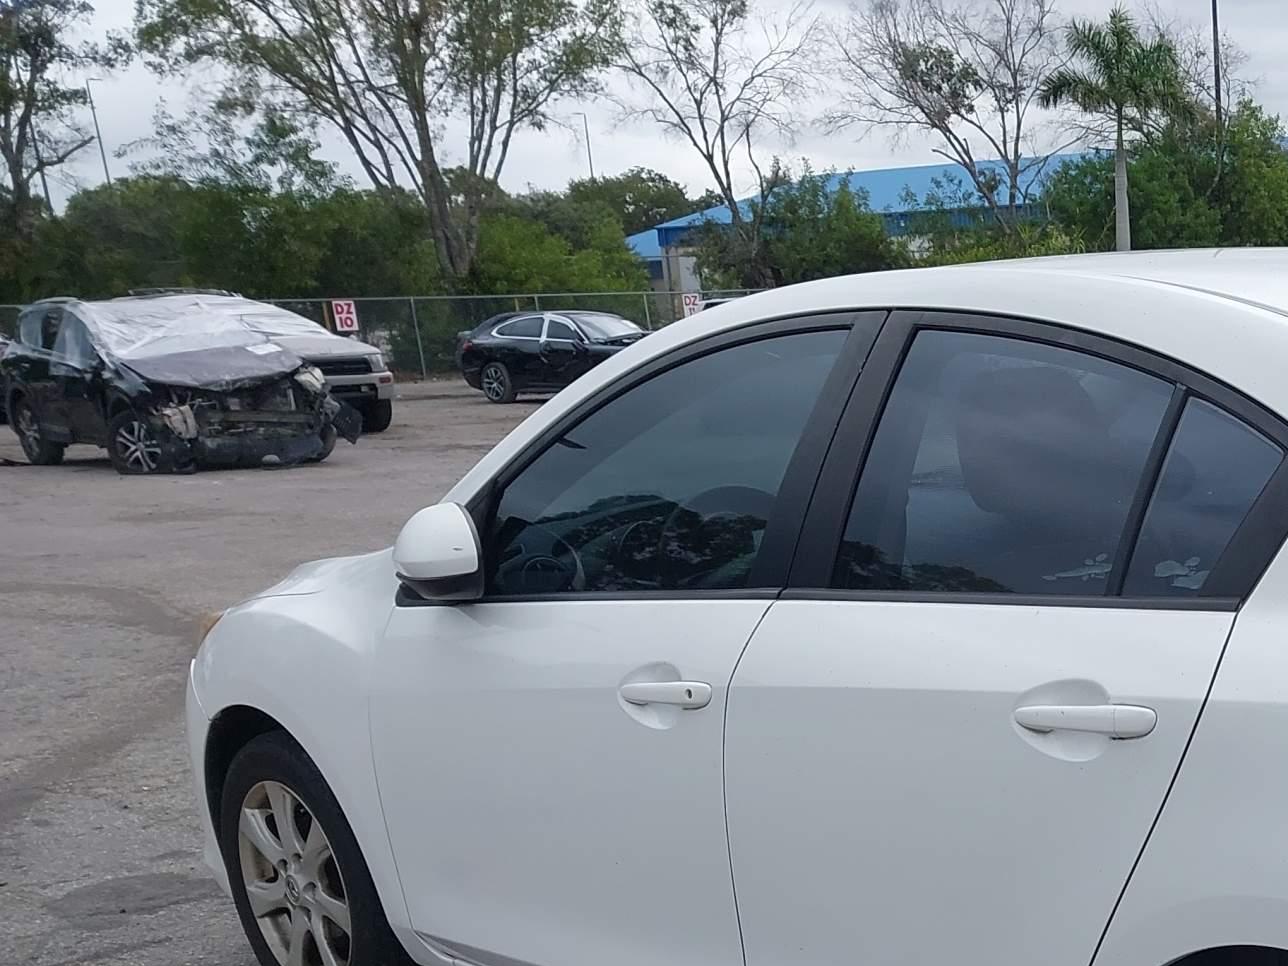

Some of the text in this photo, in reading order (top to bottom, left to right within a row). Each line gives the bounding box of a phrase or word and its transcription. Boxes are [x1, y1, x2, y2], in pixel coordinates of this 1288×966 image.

[683, 295, 699, 306] DZ
[334, 302, 353, 315] DZ
[338, 316, 354, 329] 10
